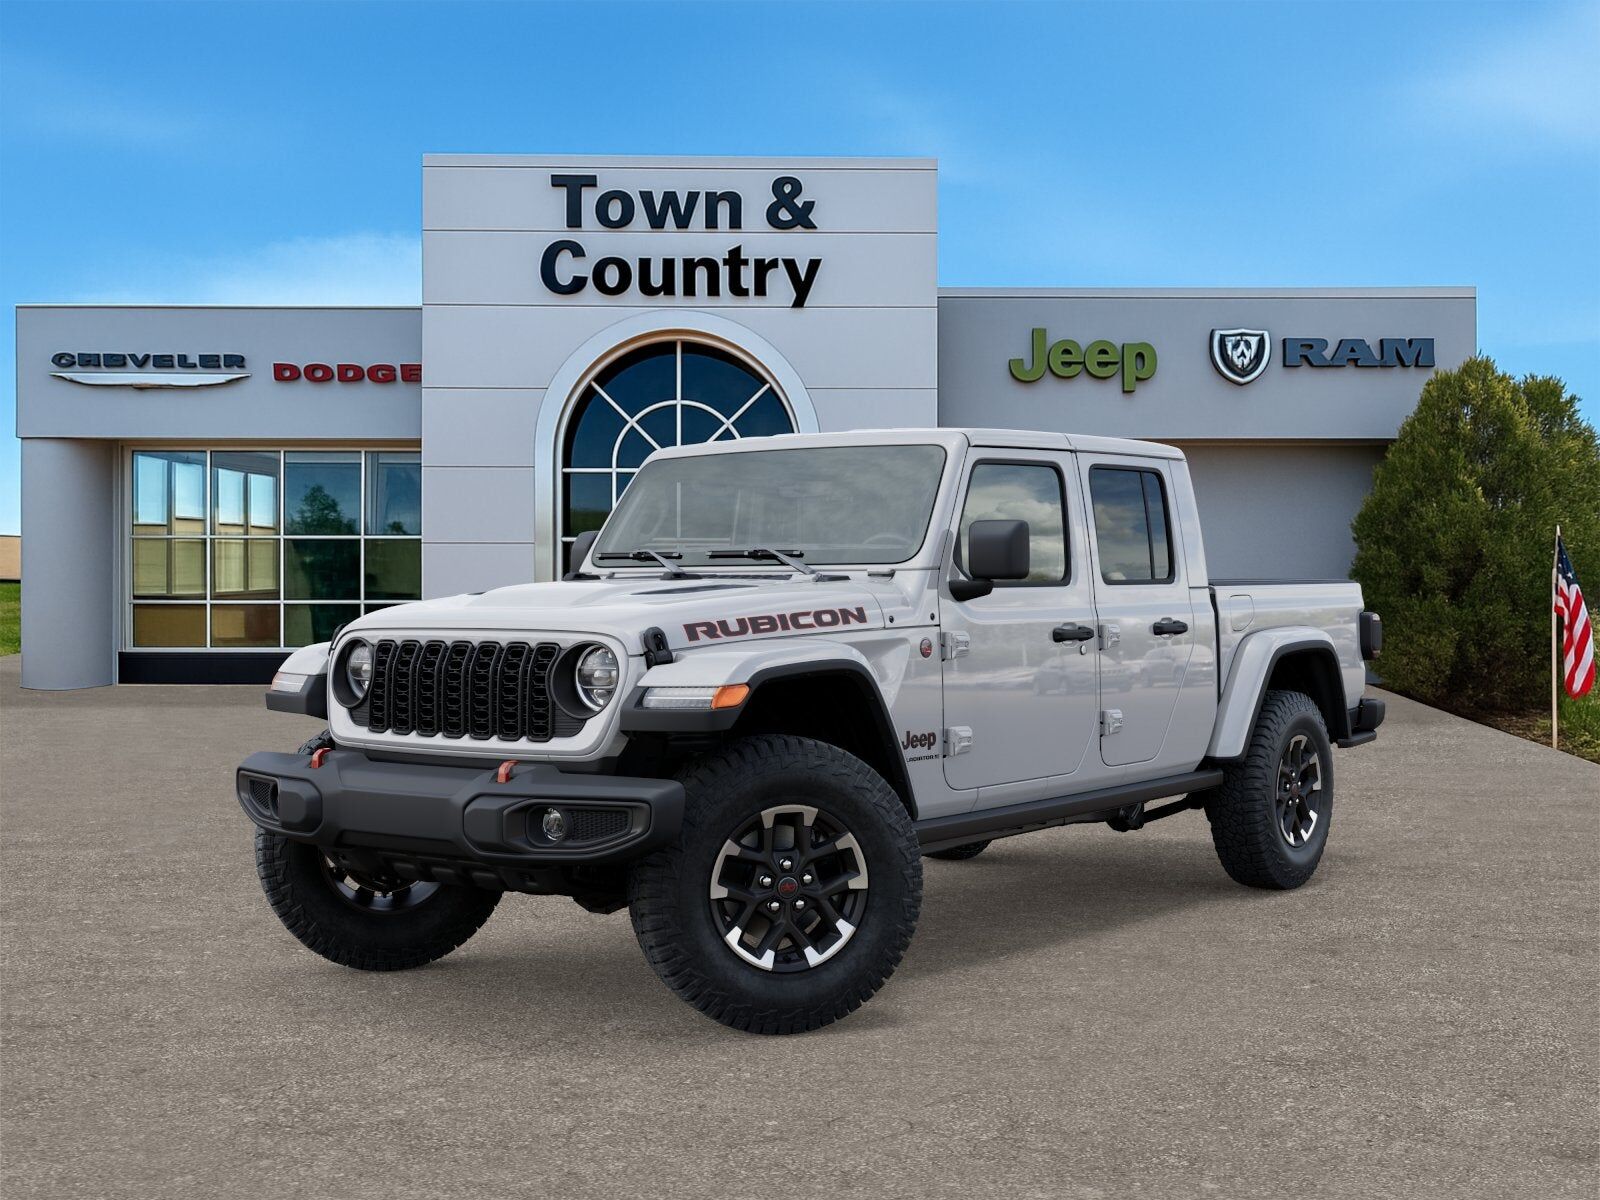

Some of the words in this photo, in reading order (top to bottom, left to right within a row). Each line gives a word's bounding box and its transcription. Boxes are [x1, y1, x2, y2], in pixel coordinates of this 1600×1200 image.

[550, 174, 743, 230] Town
[765, 175, 818, 230] &
[539, 239, 823, 308] Country
[1008, 328, 1158, 393] Jeep
[1283, 337, 1436, 367] RAM
[272, 362, 422, 383] DODGE
[683, 606, 868, 642] RUBICON
[901, 730, 937, 751] Jeep
